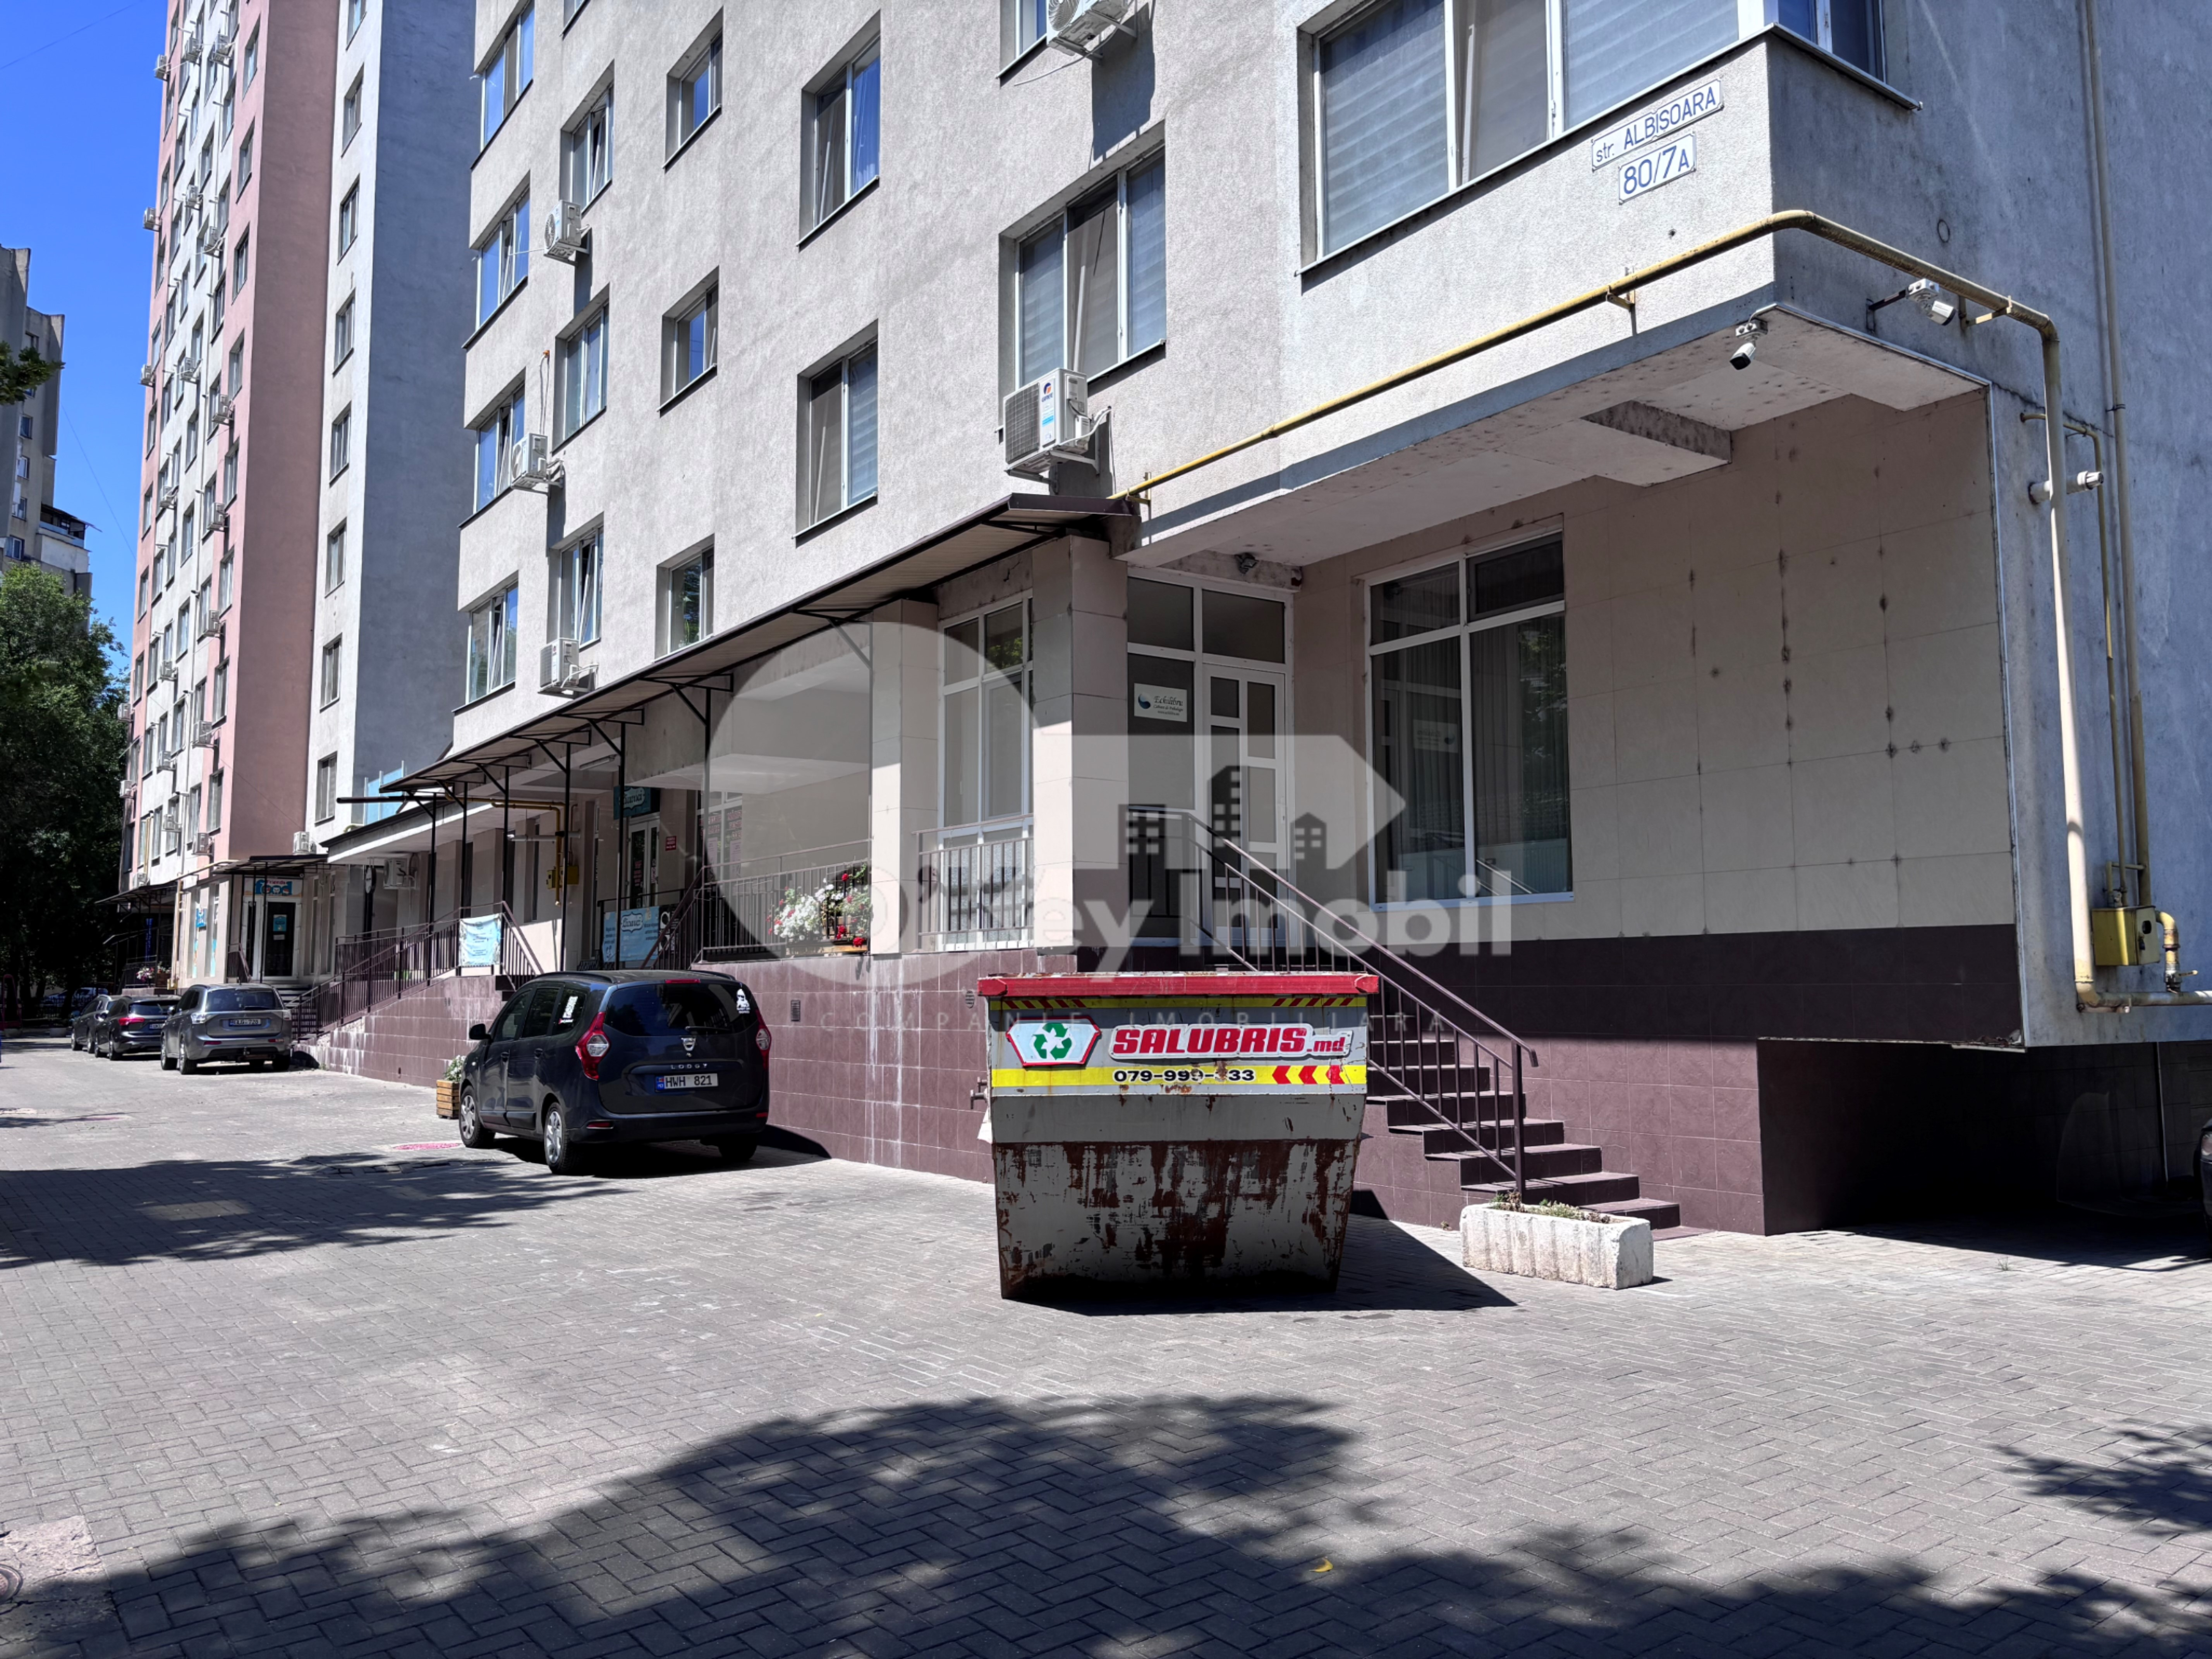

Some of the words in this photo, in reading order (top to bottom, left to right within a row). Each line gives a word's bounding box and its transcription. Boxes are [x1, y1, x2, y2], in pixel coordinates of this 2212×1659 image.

[1596, 143, 1614, 163] str.
[1624, 86, 1716, 150] ALBISOARA
[1623, 145, 1690, 194] 80/7A
[665, 1076, 686, 1087] HWH
[694, 1075, 712, 1086] 821
